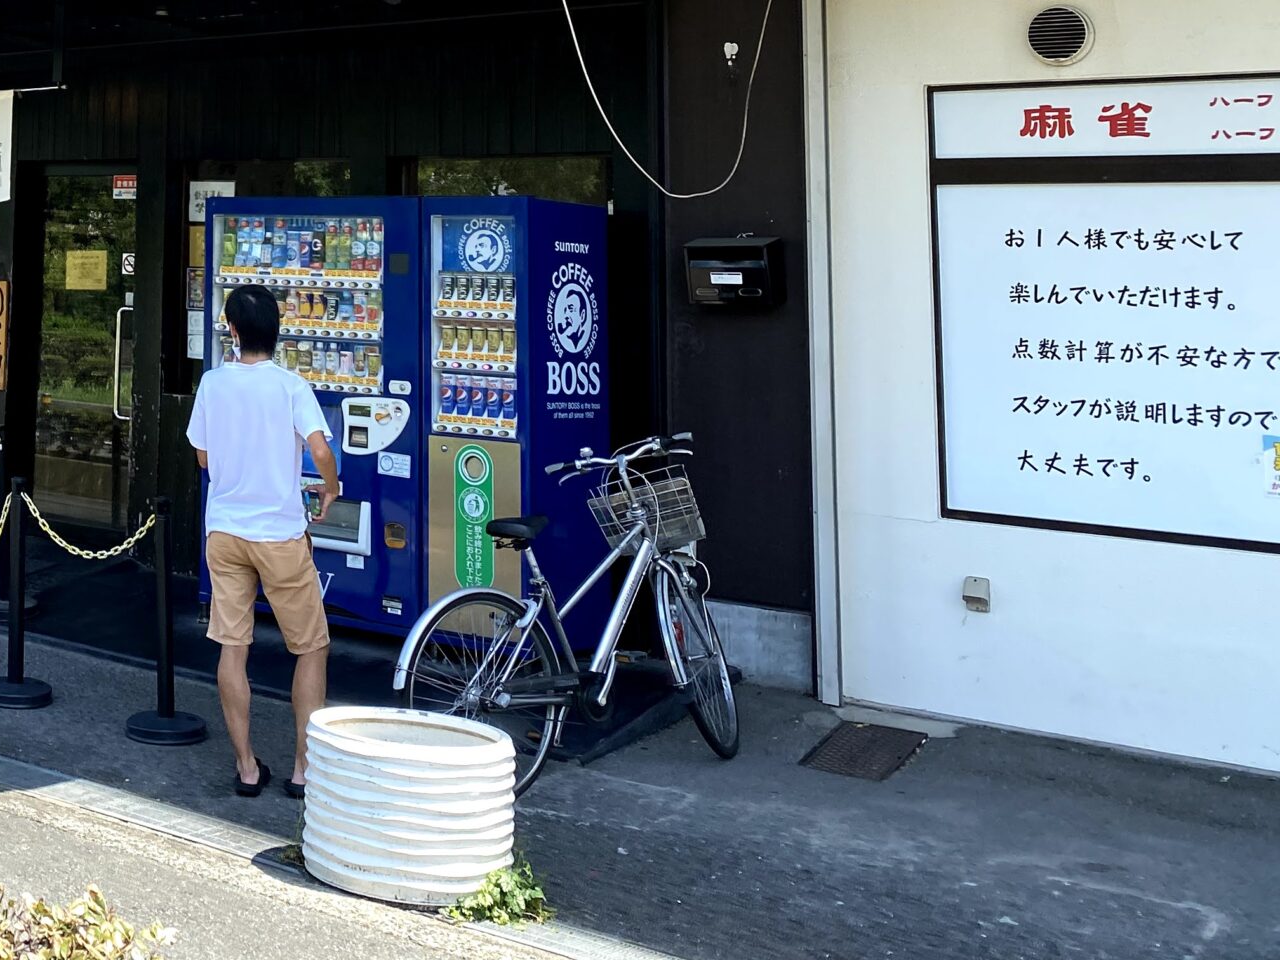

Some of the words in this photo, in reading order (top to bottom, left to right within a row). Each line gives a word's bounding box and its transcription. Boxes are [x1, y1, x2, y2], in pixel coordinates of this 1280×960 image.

[1020, 102, 1153, 139] 麻雀
[463, 218, 506, 235] COFFEE
[552, 263, 594, 292] COFFEE
[546, 289, 557, 331] COFFEE
[1009, 282, 1238, 311] 楽しんでいただけます。
[546, 361, 601, 395] BOSS
[1012, 395, 1278, 430] スタッフが説明しますので
[1017, 449, 1152, 483] 大丈夫です。
